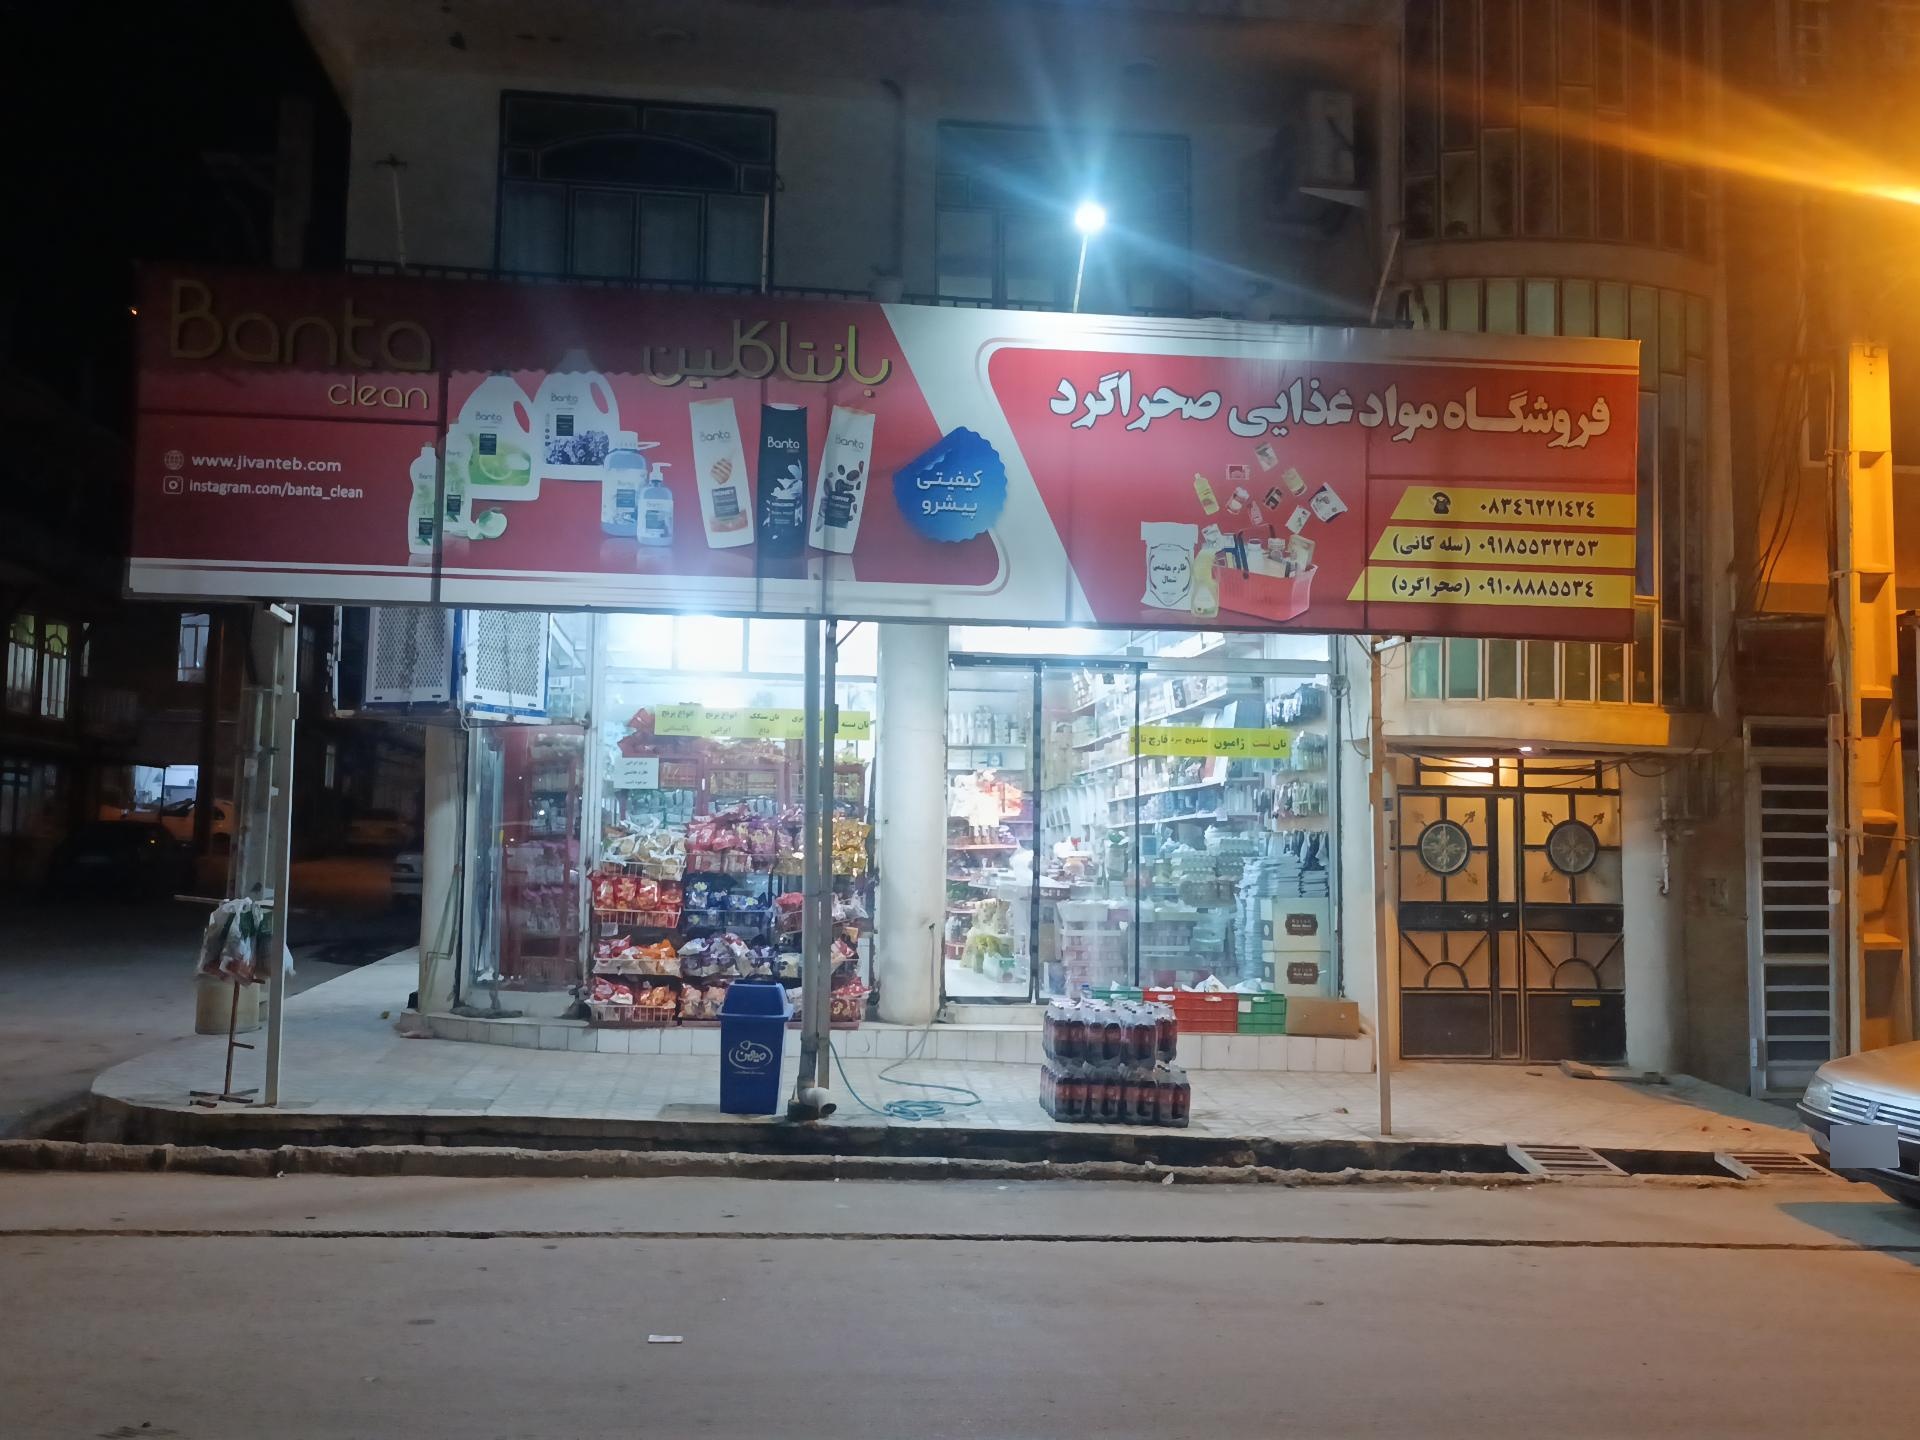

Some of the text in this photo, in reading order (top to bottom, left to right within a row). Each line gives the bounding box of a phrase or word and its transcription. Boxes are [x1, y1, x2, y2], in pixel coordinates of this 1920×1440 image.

[170, 279, 432, 371] Banta
[328, 376, 429, 409] clean
[1228, 377, 1353, 439] غذایی
[1358, 385, 1438, 441] مواد
[1443, 391, 1611, 448] فروشگاه
[767, 436, 800, 450] Banta
[191, 454, 342, 473] www.jivanteb.com
[916, 471, 983, 491] کیفیتی
[920, 498, 979, 520] پیشرو
